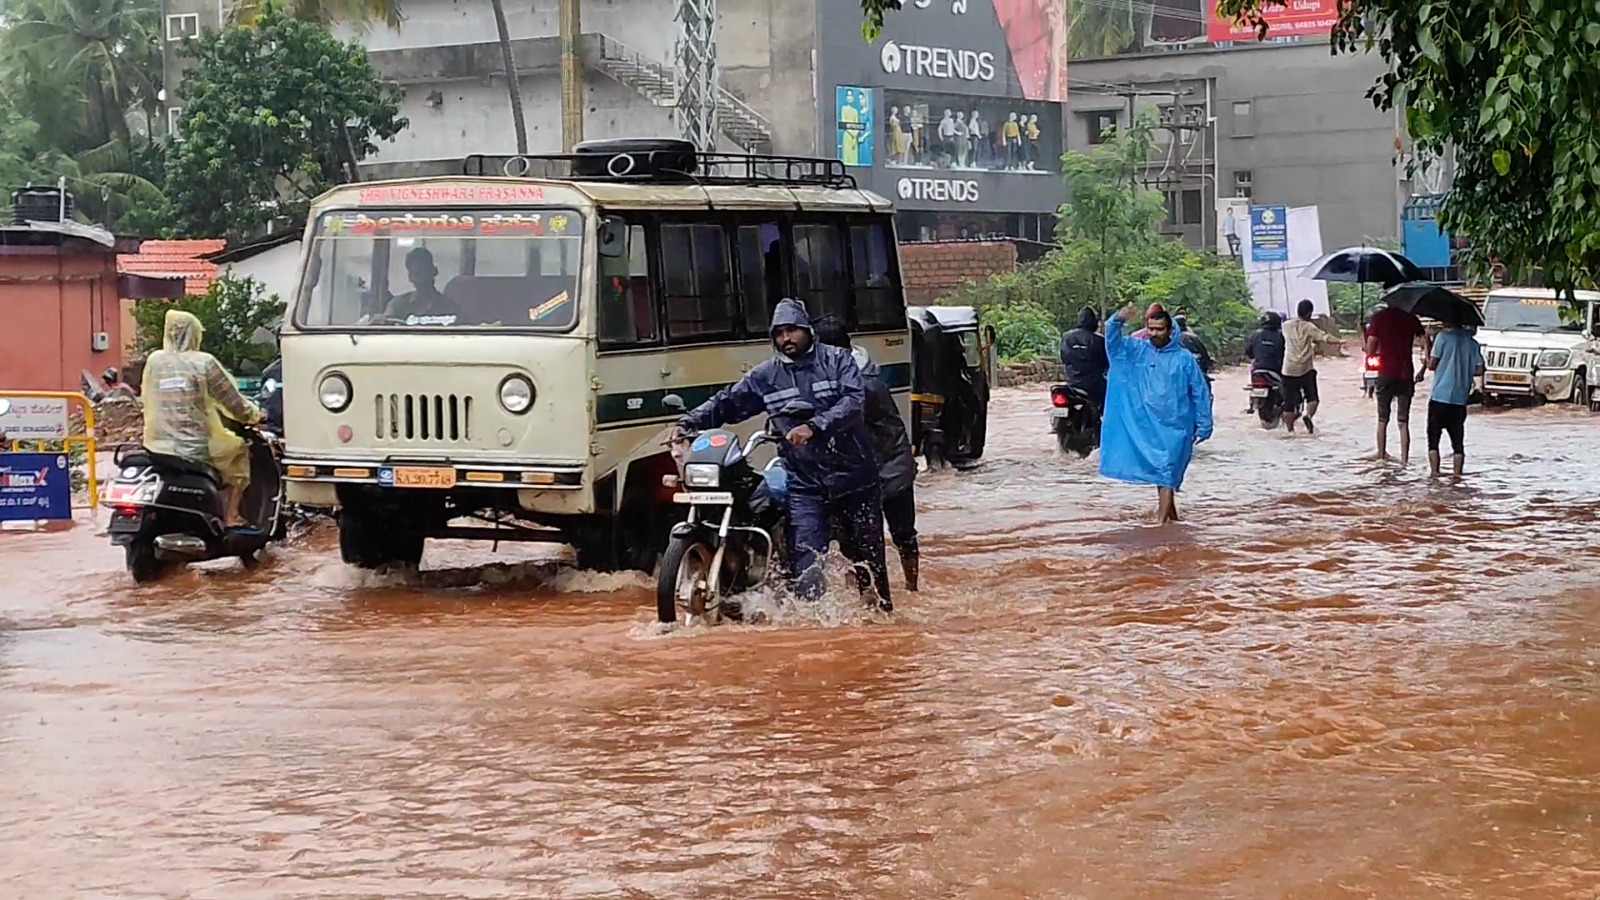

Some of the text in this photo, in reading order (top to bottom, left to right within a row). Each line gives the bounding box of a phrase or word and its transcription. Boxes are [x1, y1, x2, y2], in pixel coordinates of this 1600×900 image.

[899, 45, 994, 81] TRENDS
[390, 187, 475, 201] VIGNESHWARA
[479, 186, 544, 200] PRASANNA
[910, 178, 979, 202] TRENDS
